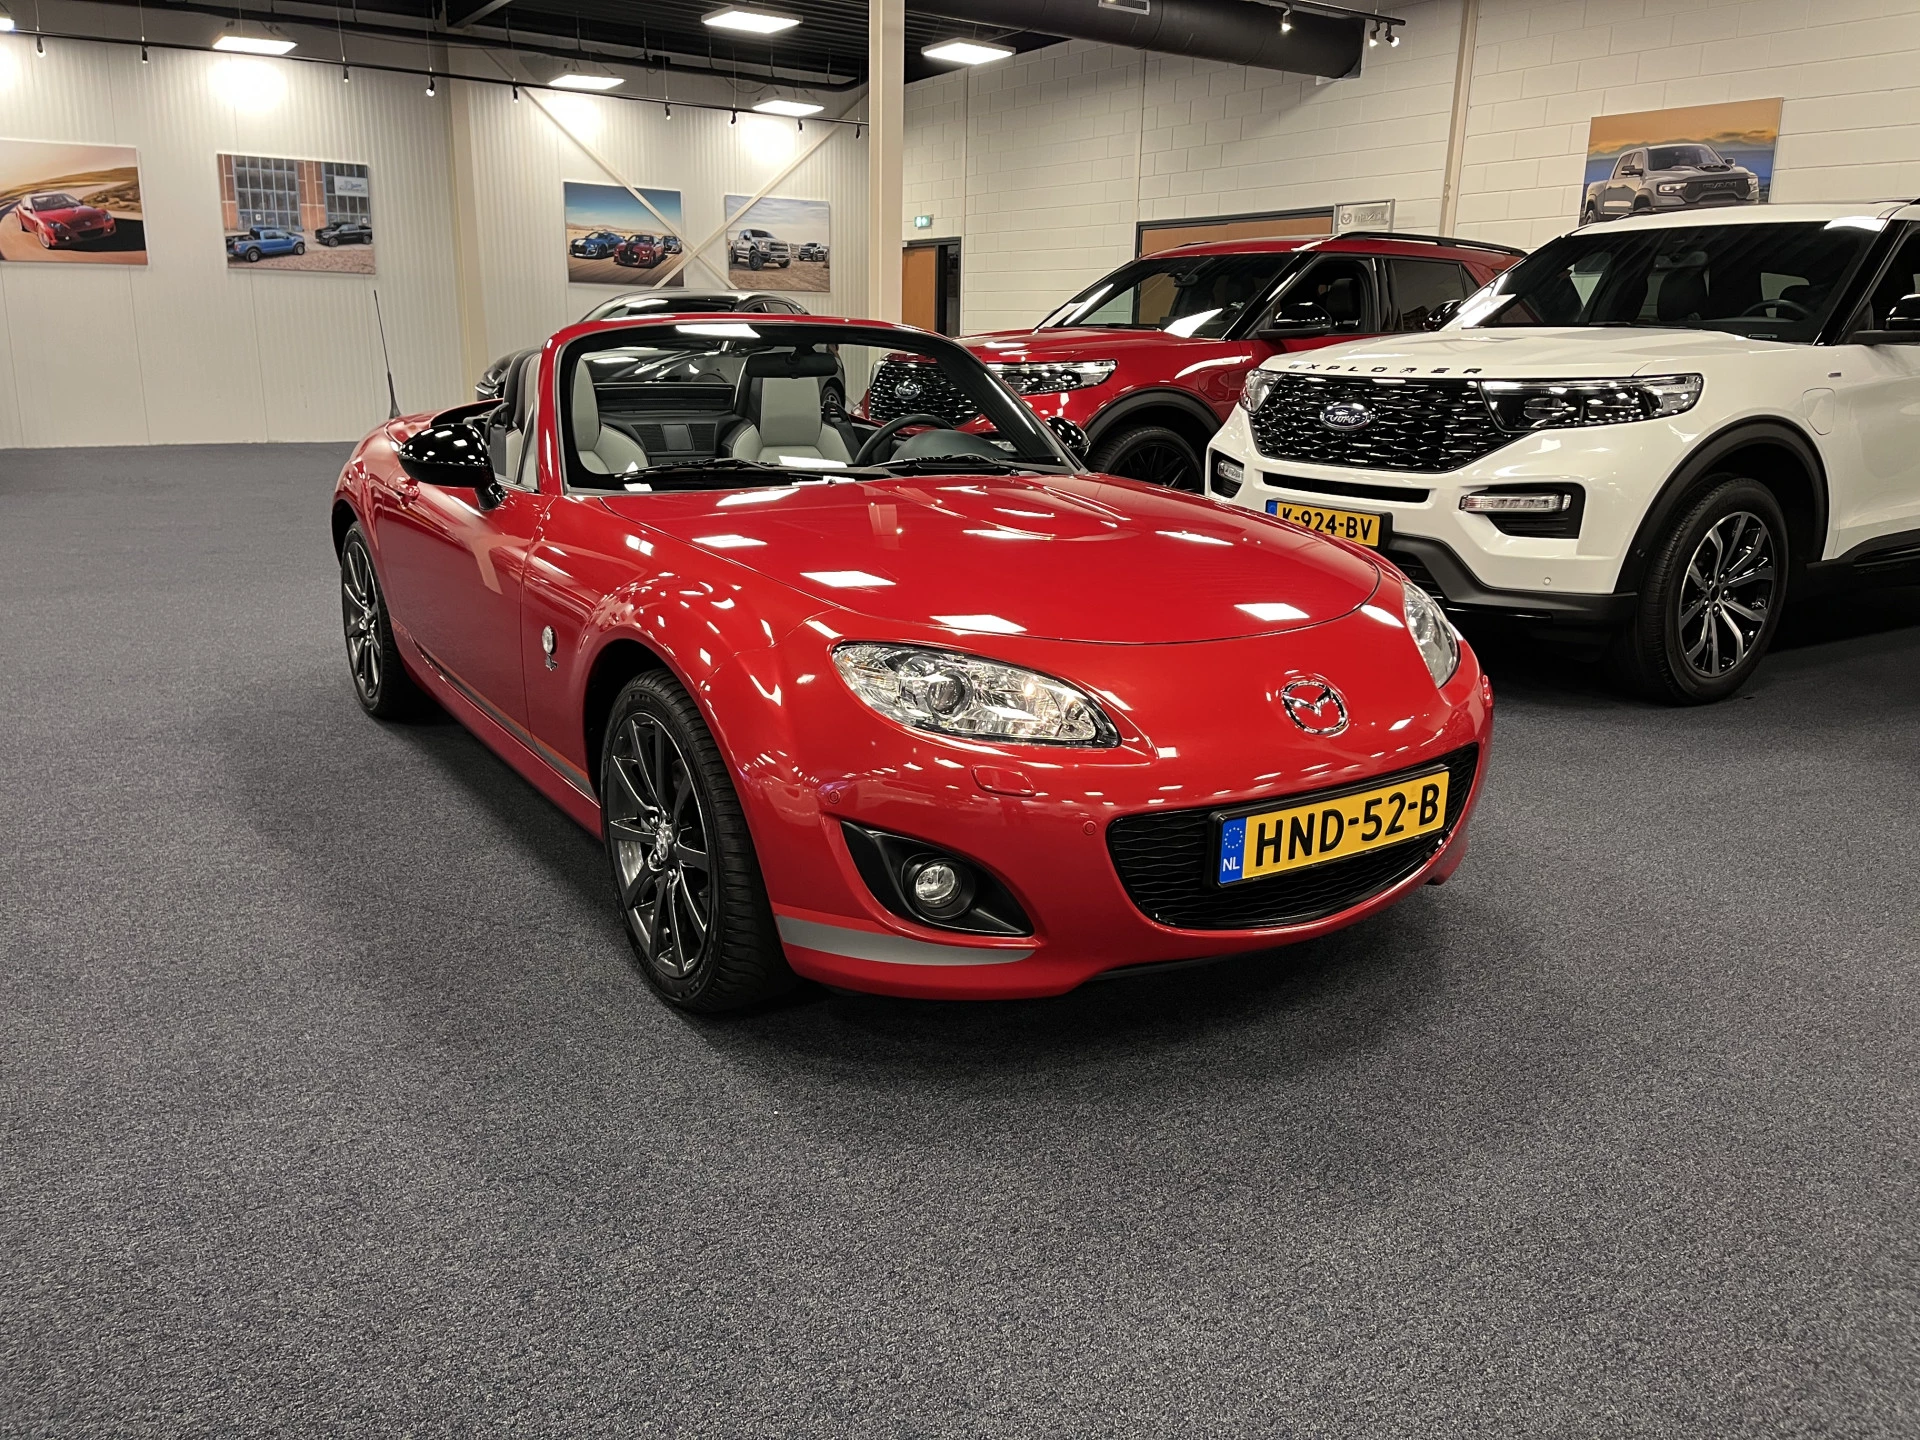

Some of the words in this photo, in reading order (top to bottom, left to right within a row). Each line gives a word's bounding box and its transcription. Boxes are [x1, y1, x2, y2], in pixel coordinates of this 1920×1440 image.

[1288, 363, 1482, 374] EXPLORER
[1326, 409, 1361, 424] Ford
[1255, 783, 1440, 867] HND-52-B
[1222, 856, 1240, 872] NL
